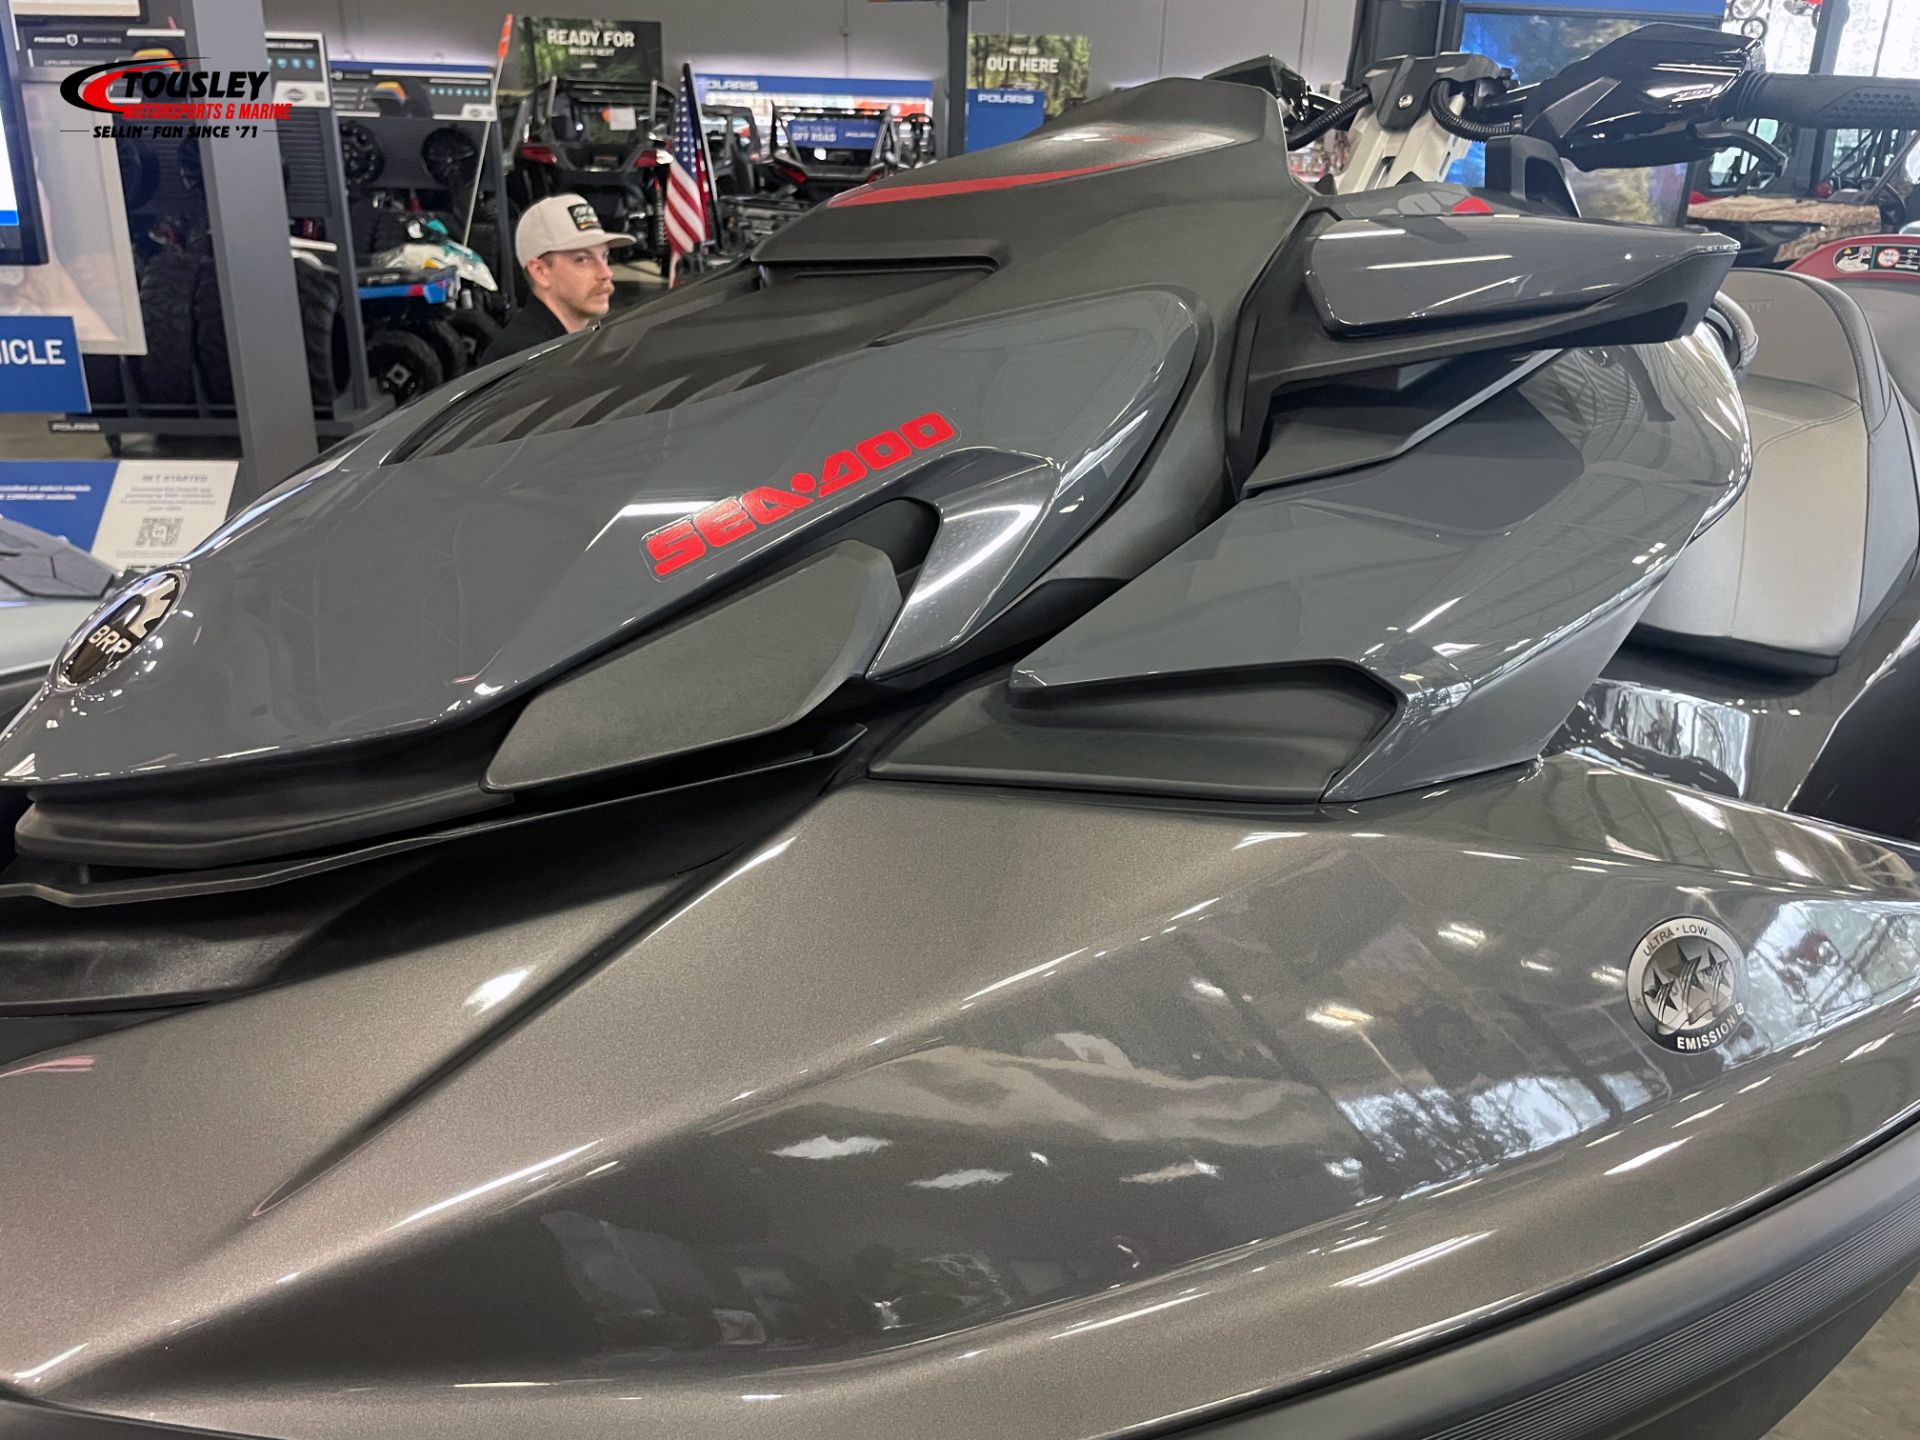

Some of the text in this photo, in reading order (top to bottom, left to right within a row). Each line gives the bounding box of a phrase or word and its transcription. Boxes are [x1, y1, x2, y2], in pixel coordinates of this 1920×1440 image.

[547, 28, 635, 48] READY FOR
[986, 56, 1060, 73] OUT HERE
[698, 78, 759, 90] OLARIS
[977, 93, 1035, 104] POLARIS
[0, 338, 67, 365] ICLE
[89, 624, 132, 655] BRP
[1643, 924, 1708, 956] ULTRA LOW
[1676, 1014, 1736, 1050] EMISSION
